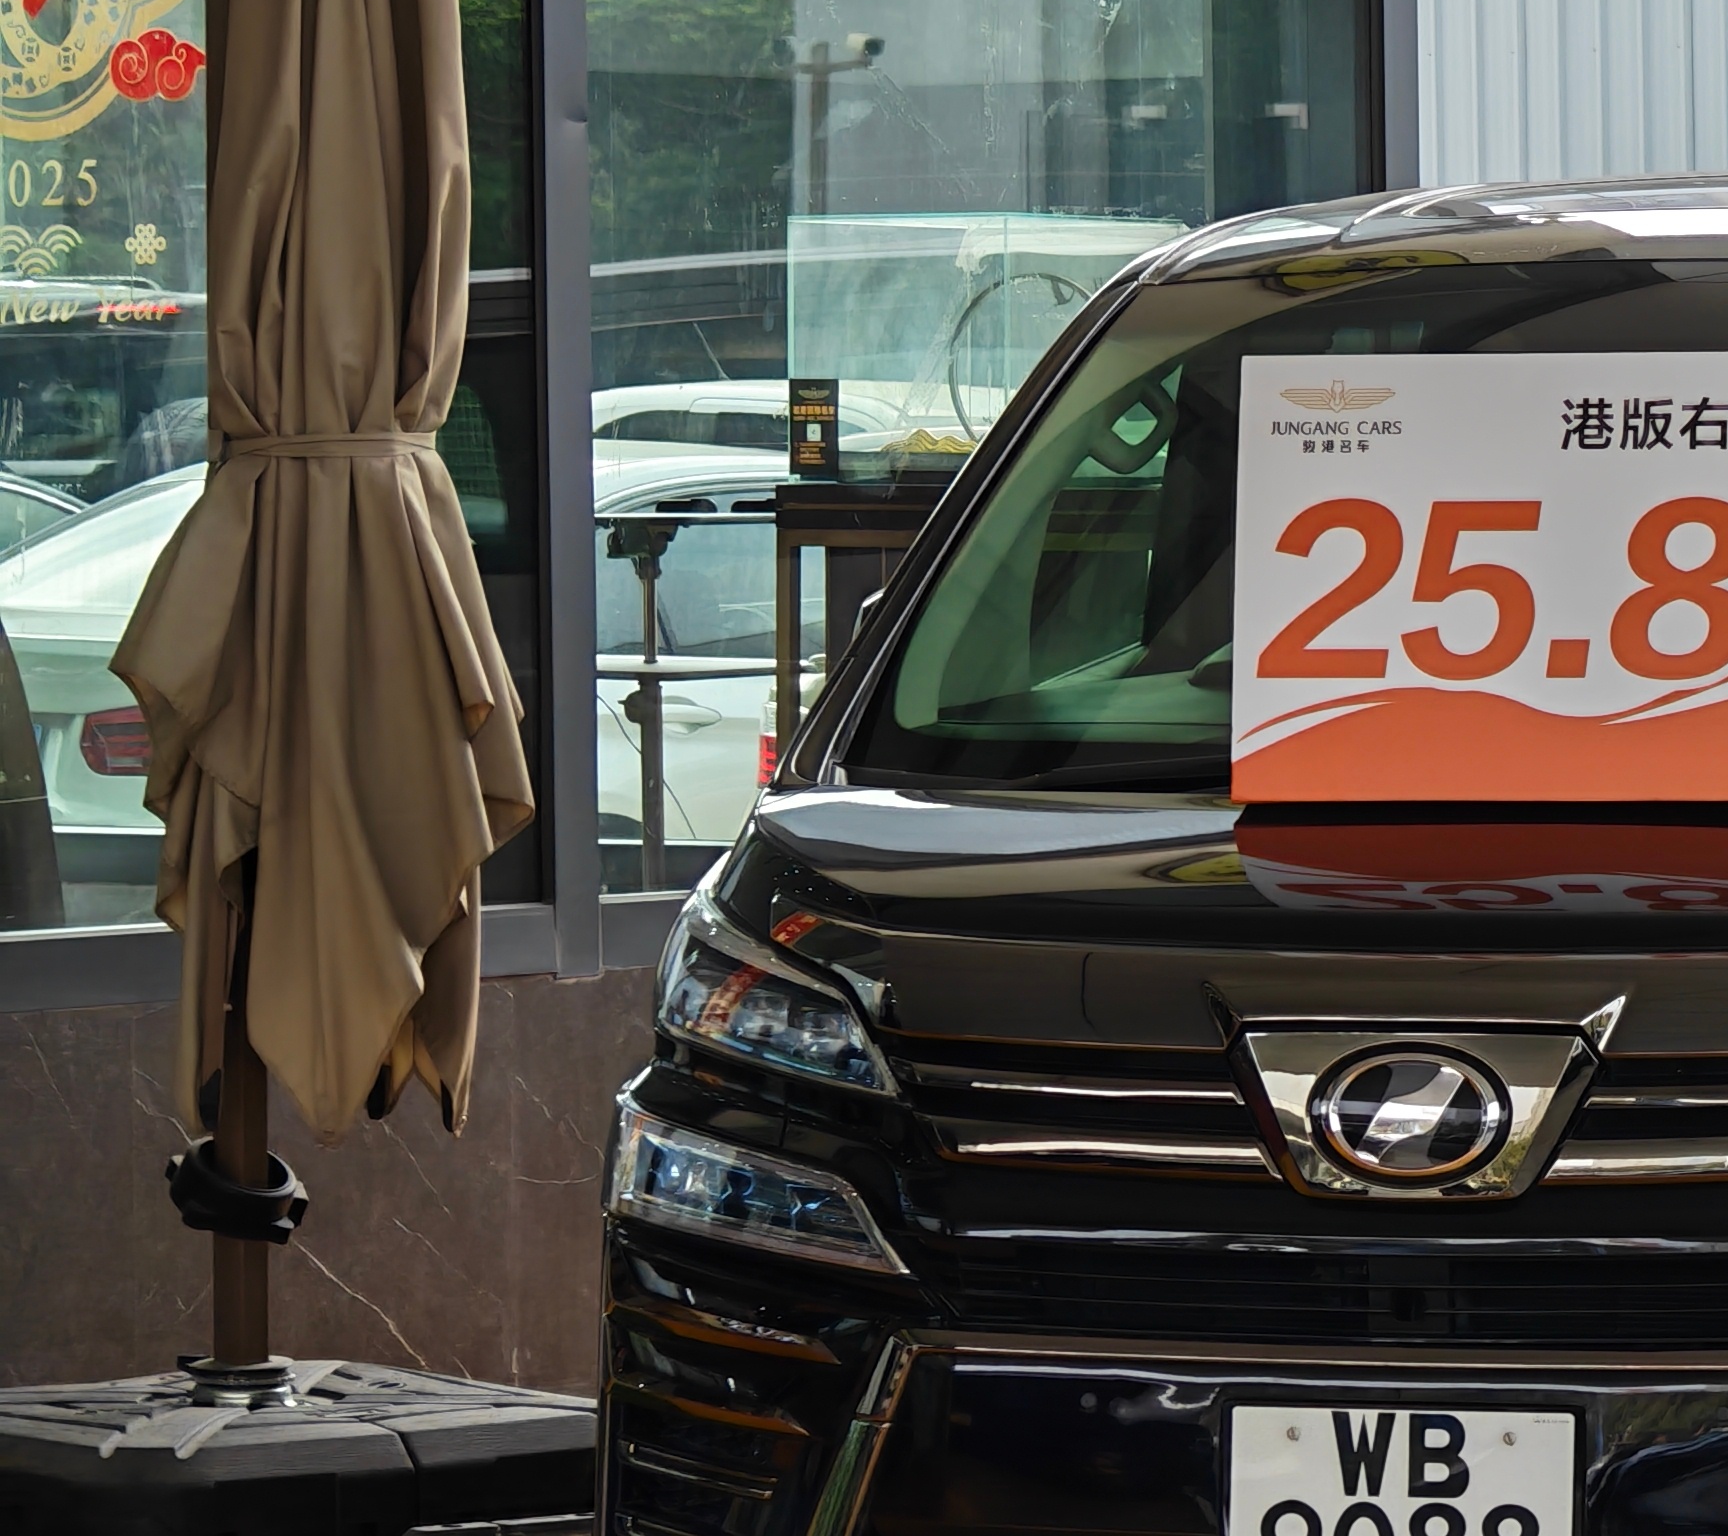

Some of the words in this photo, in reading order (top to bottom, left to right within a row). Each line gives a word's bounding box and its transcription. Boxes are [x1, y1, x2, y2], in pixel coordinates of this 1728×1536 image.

[0, 290, 81, 325] New
[98, 289, 178, 322] Year
[1271, 421, 1349, 435] JUNGANG
[1357, 421, 1402, 435] CARS
[1331, 1410, 1470, 1499] WB
